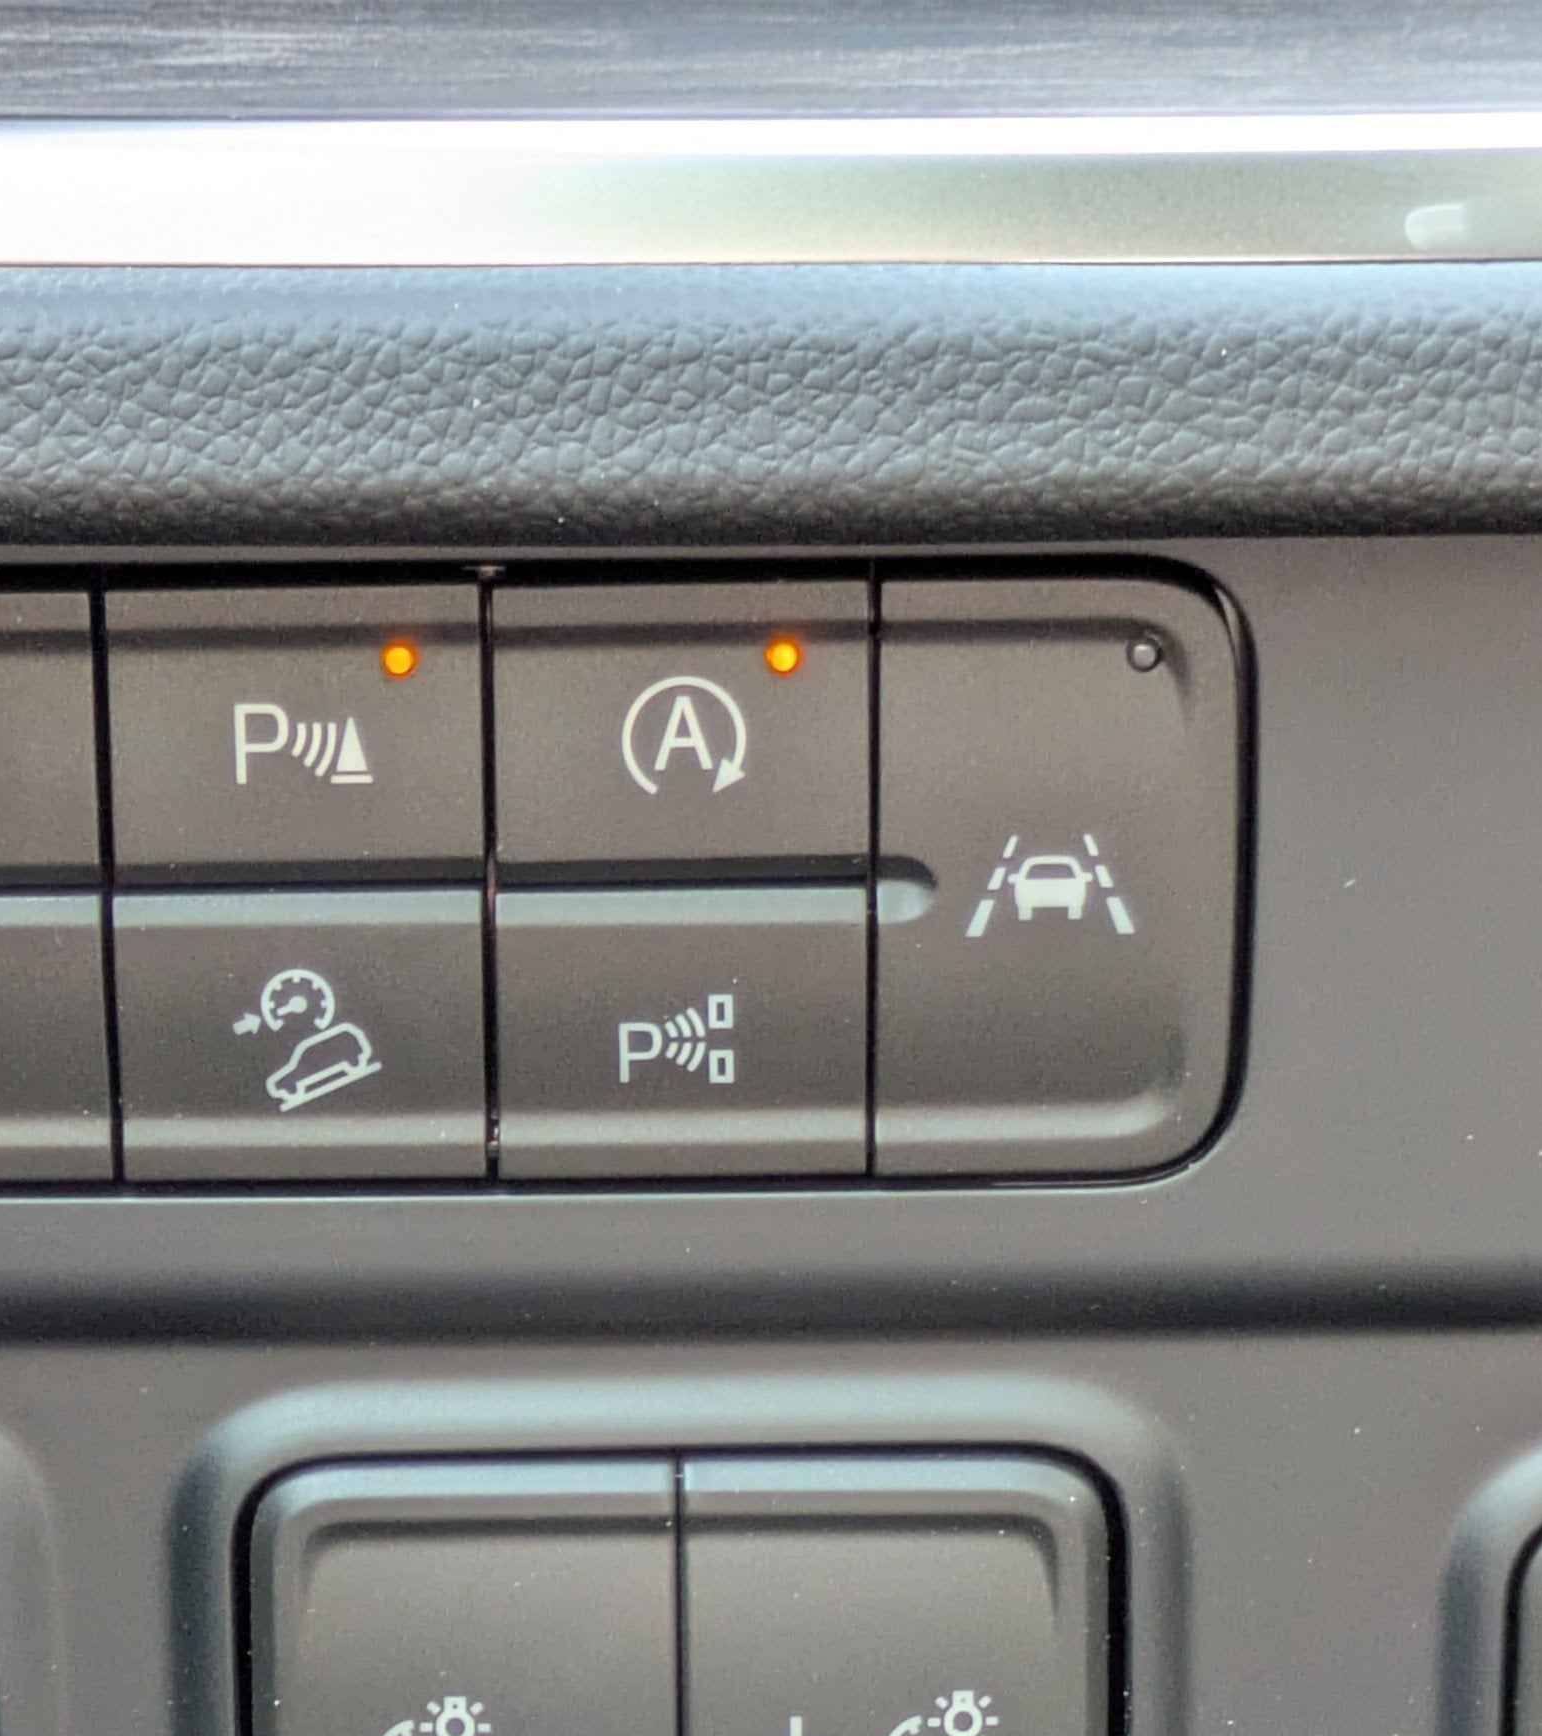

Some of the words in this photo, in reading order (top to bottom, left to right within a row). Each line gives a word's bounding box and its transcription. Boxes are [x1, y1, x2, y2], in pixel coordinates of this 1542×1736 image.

[233, 702, 289, 785] P
[653, 695, 714, 772] A
[618, 1021, 663, 1083] P
